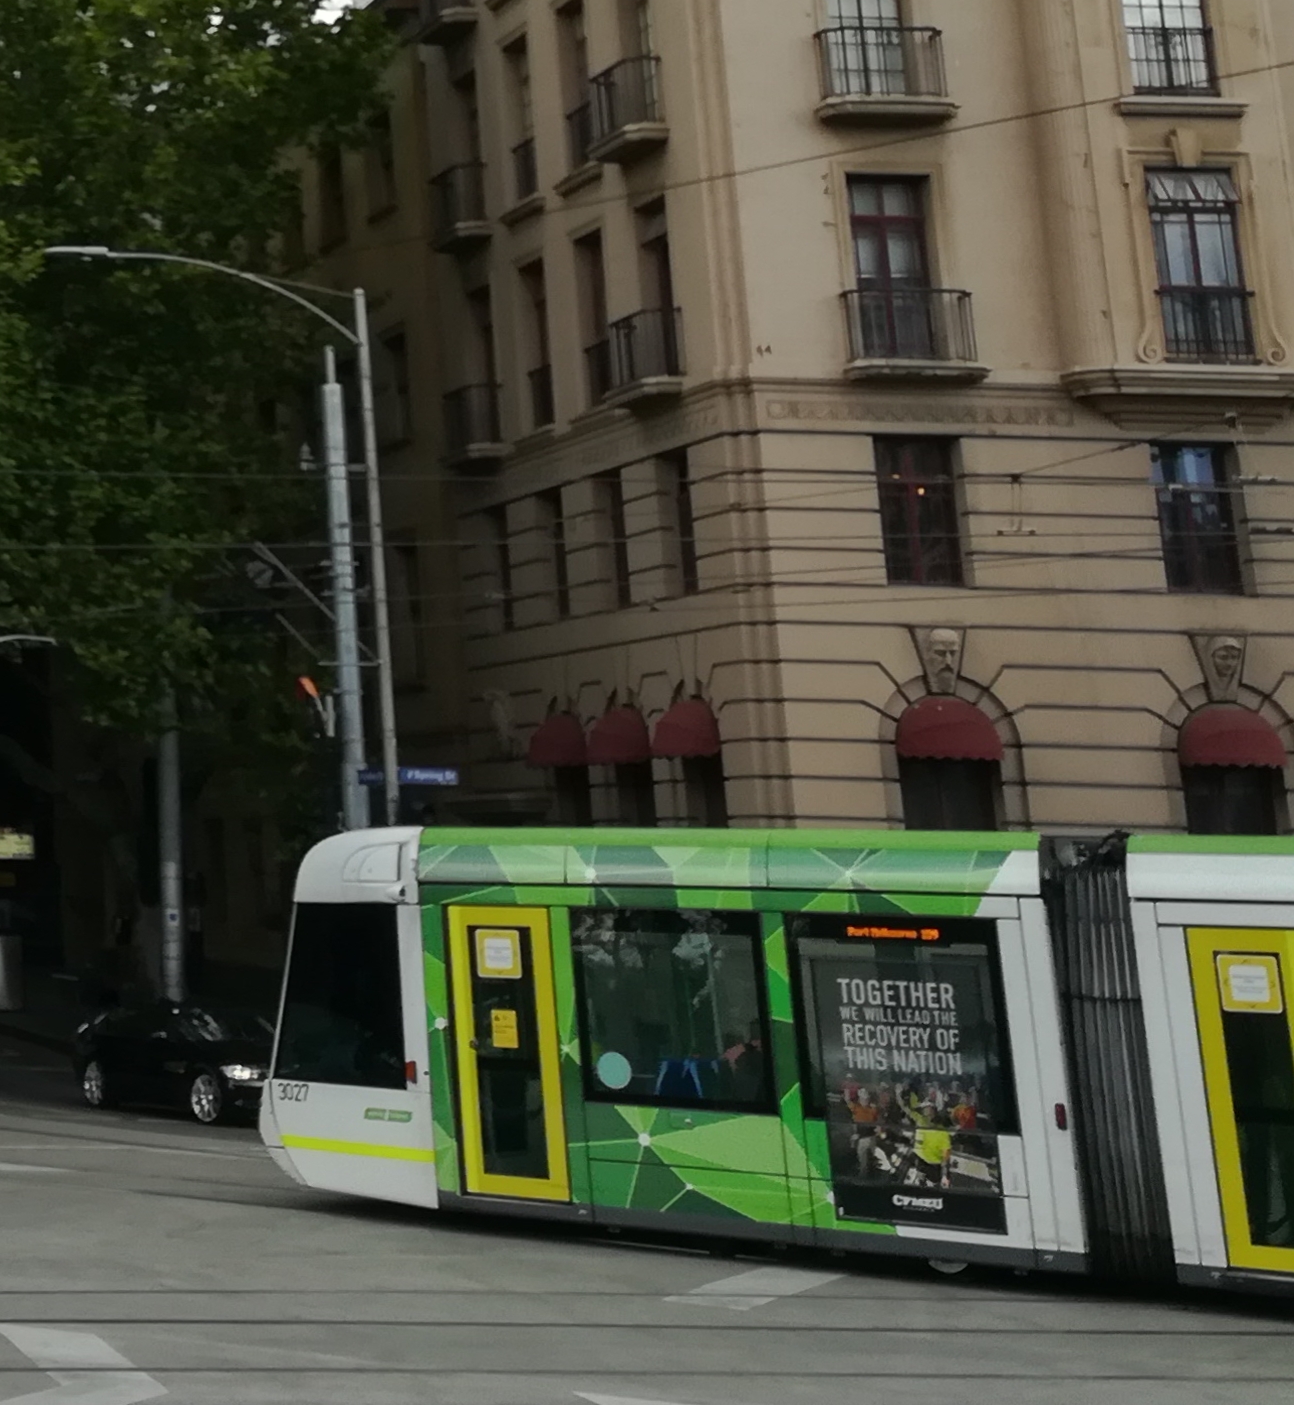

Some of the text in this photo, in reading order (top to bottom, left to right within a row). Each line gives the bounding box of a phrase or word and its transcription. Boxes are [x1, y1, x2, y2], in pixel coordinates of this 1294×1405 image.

[837, 978, 956, 1010] TOGETHER
[839, 1006, 959, 1027] WE WILL LEAD THE
[842, 1023, 959, 1051] RECOVERY OF
[843, 1046, 963, 1076] THIS NATION
[277, 1083, 310, 1102] 3027
